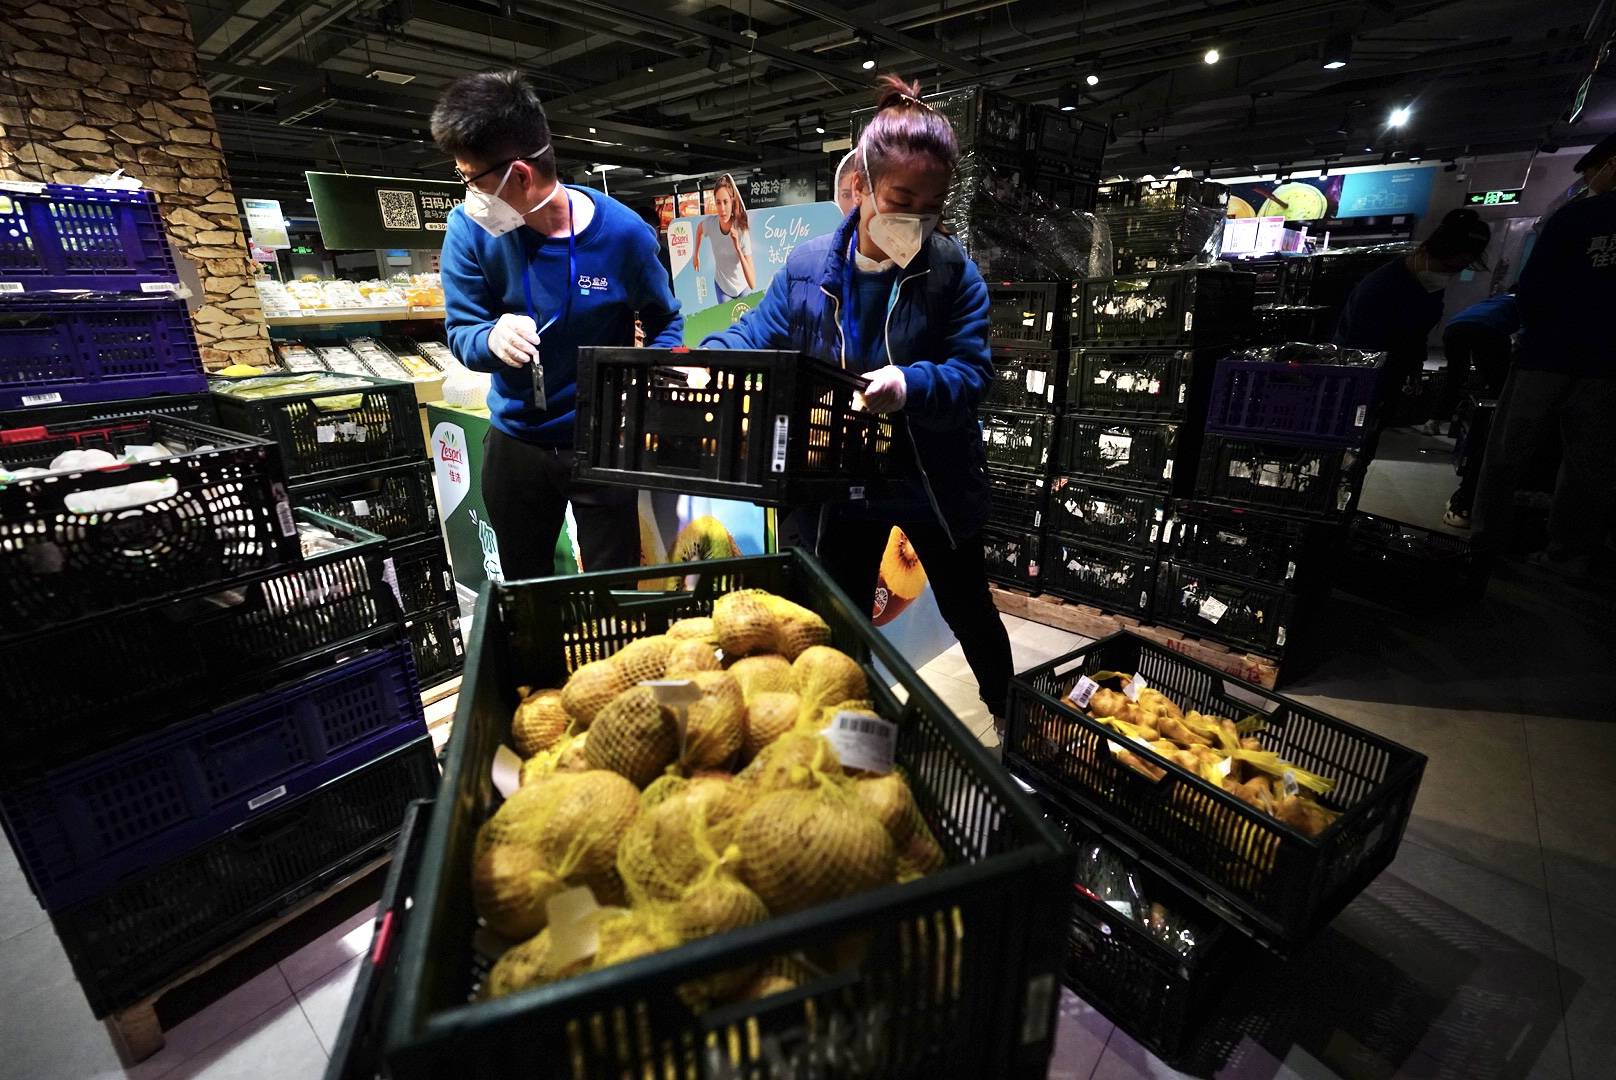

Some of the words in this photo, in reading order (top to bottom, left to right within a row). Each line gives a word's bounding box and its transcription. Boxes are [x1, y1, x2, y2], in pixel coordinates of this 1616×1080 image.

[764, 215, 787, 245] Say
[789, 217, 810, 242] Yes
[439, 440, 463, 464] Zespri
